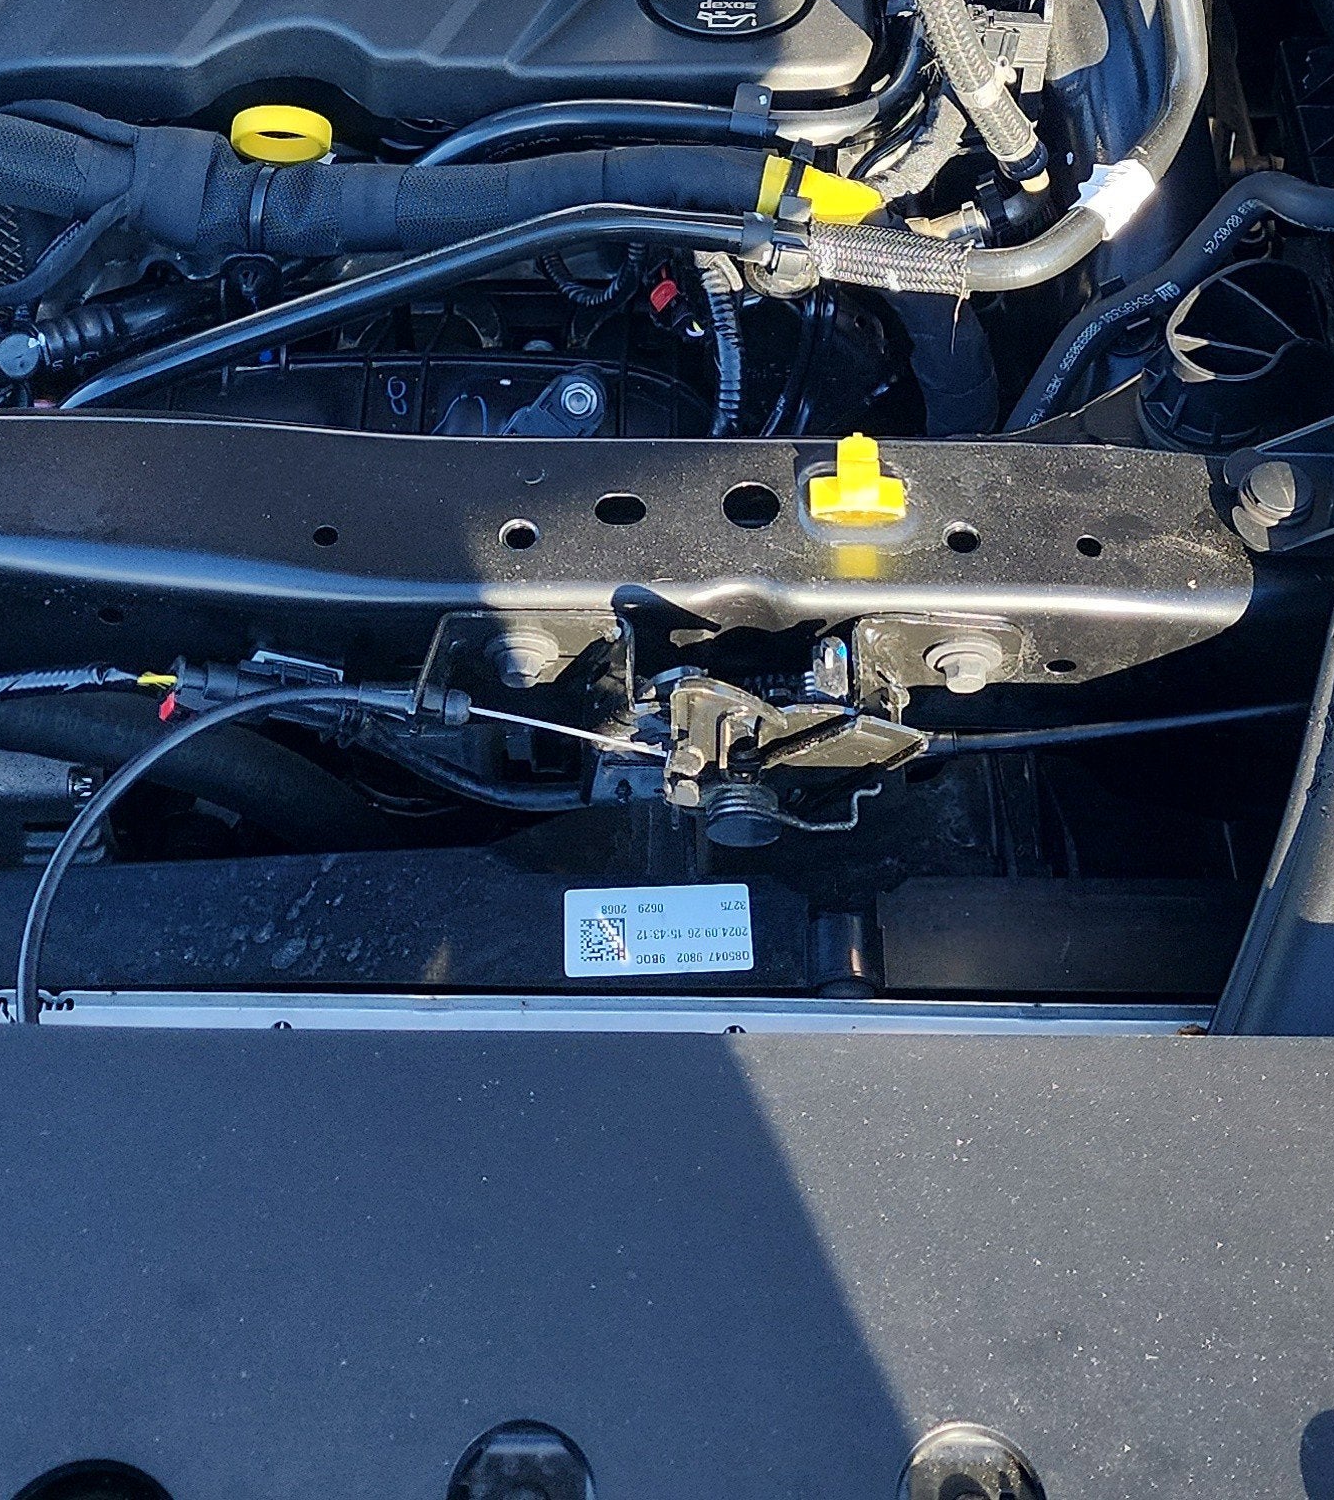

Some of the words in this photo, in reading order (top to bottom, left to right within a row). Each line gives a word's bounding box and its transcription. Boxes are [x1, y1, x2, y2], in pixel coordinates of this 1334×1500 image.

[699, 0, 757, 10] dexos
[638, 903, 664, 913] 0629
[720, 901, 747, 910] 3275
